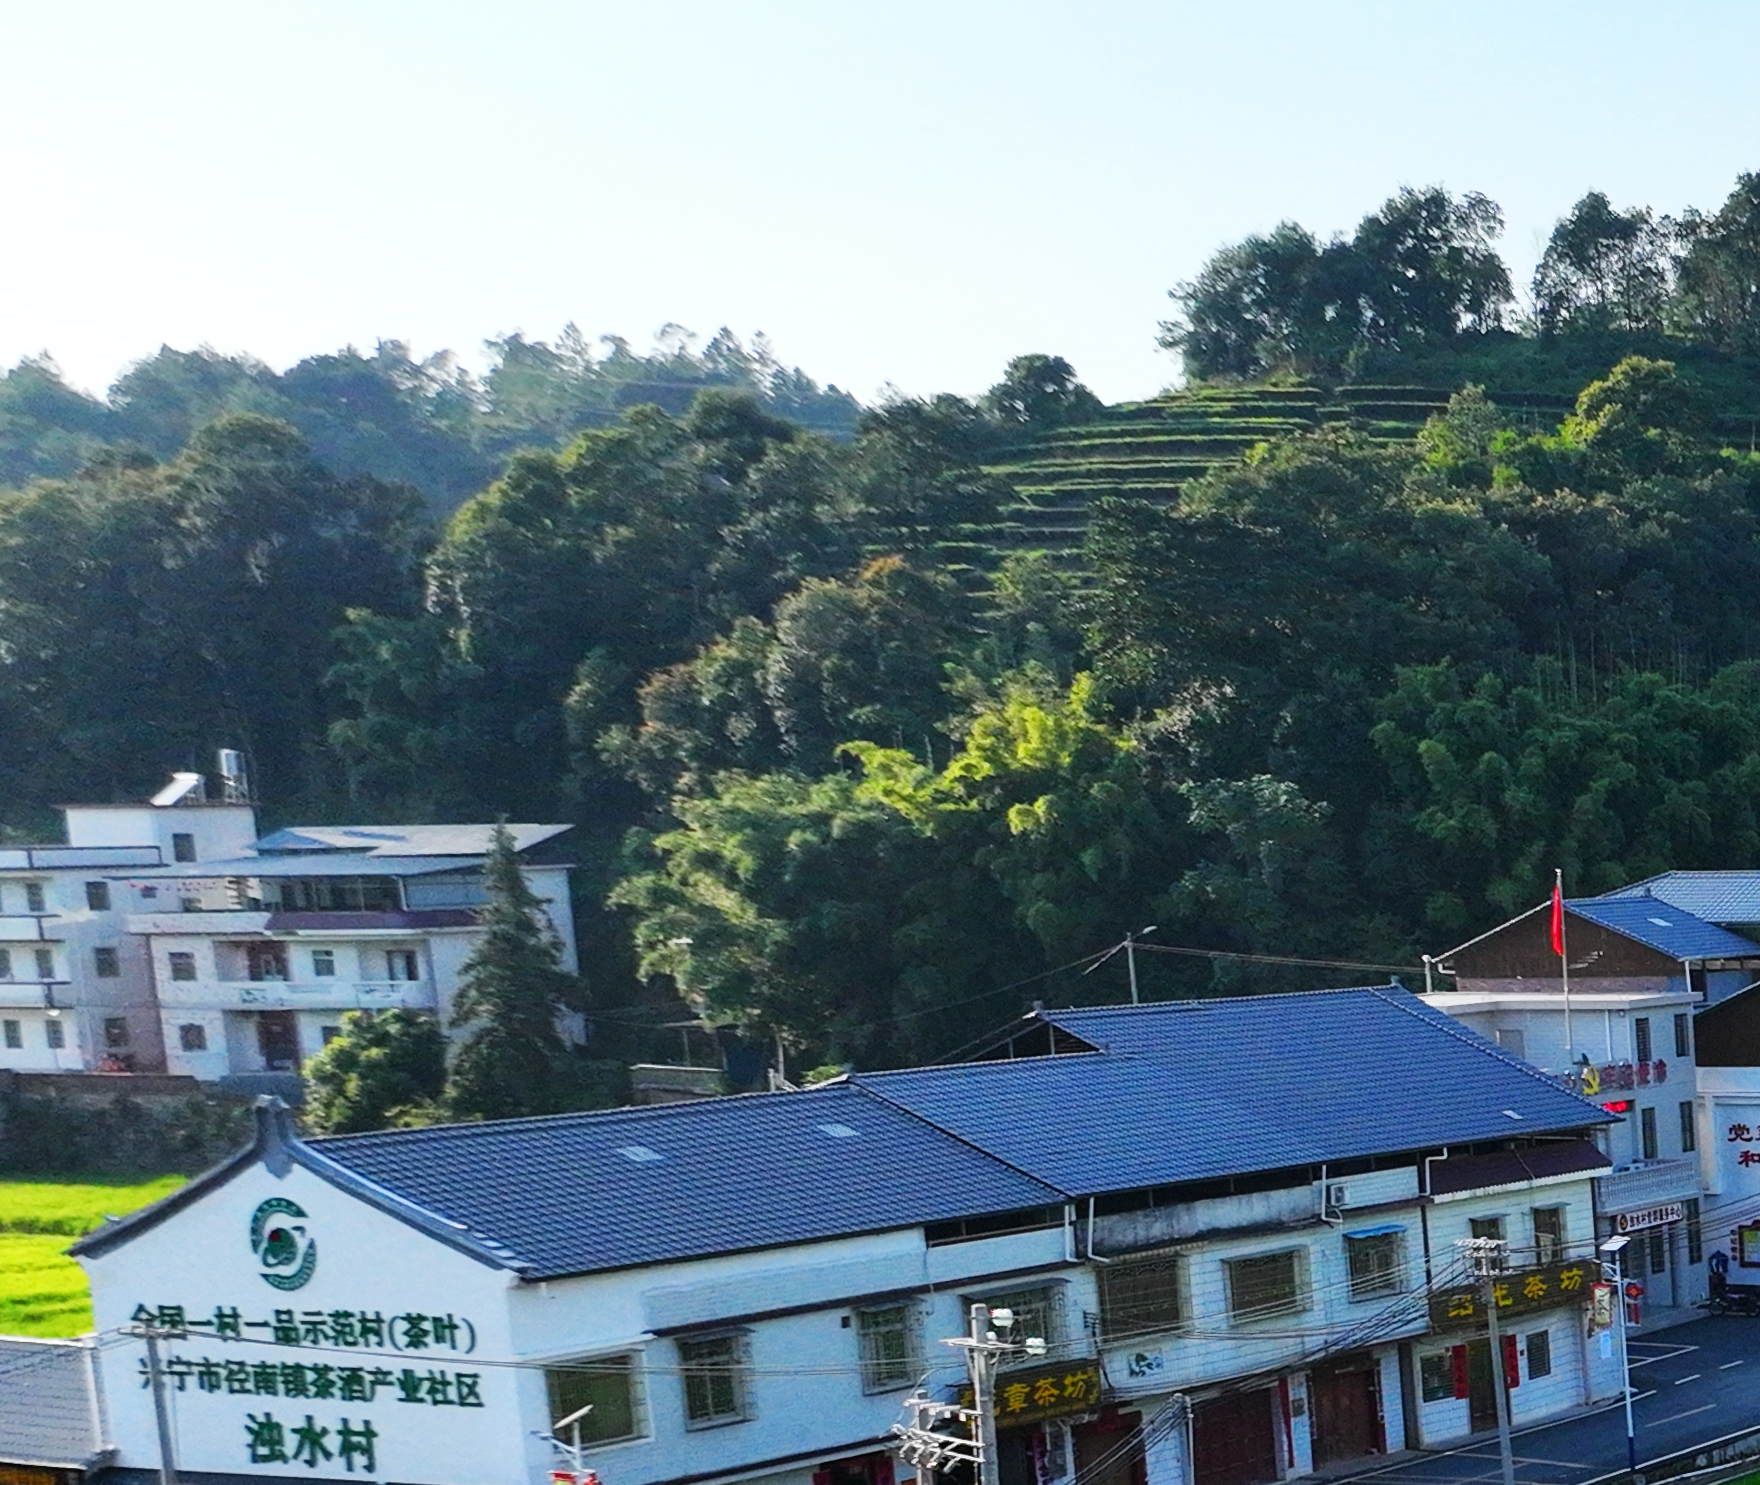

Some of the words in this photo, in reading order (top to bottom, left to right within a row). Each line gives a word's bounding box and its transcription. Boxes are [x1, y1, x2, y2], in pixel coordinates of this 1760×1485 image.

[988, 1371, 1088, 1417] 章茶坊
[244, 1411, 379, 1474] 浊水村
